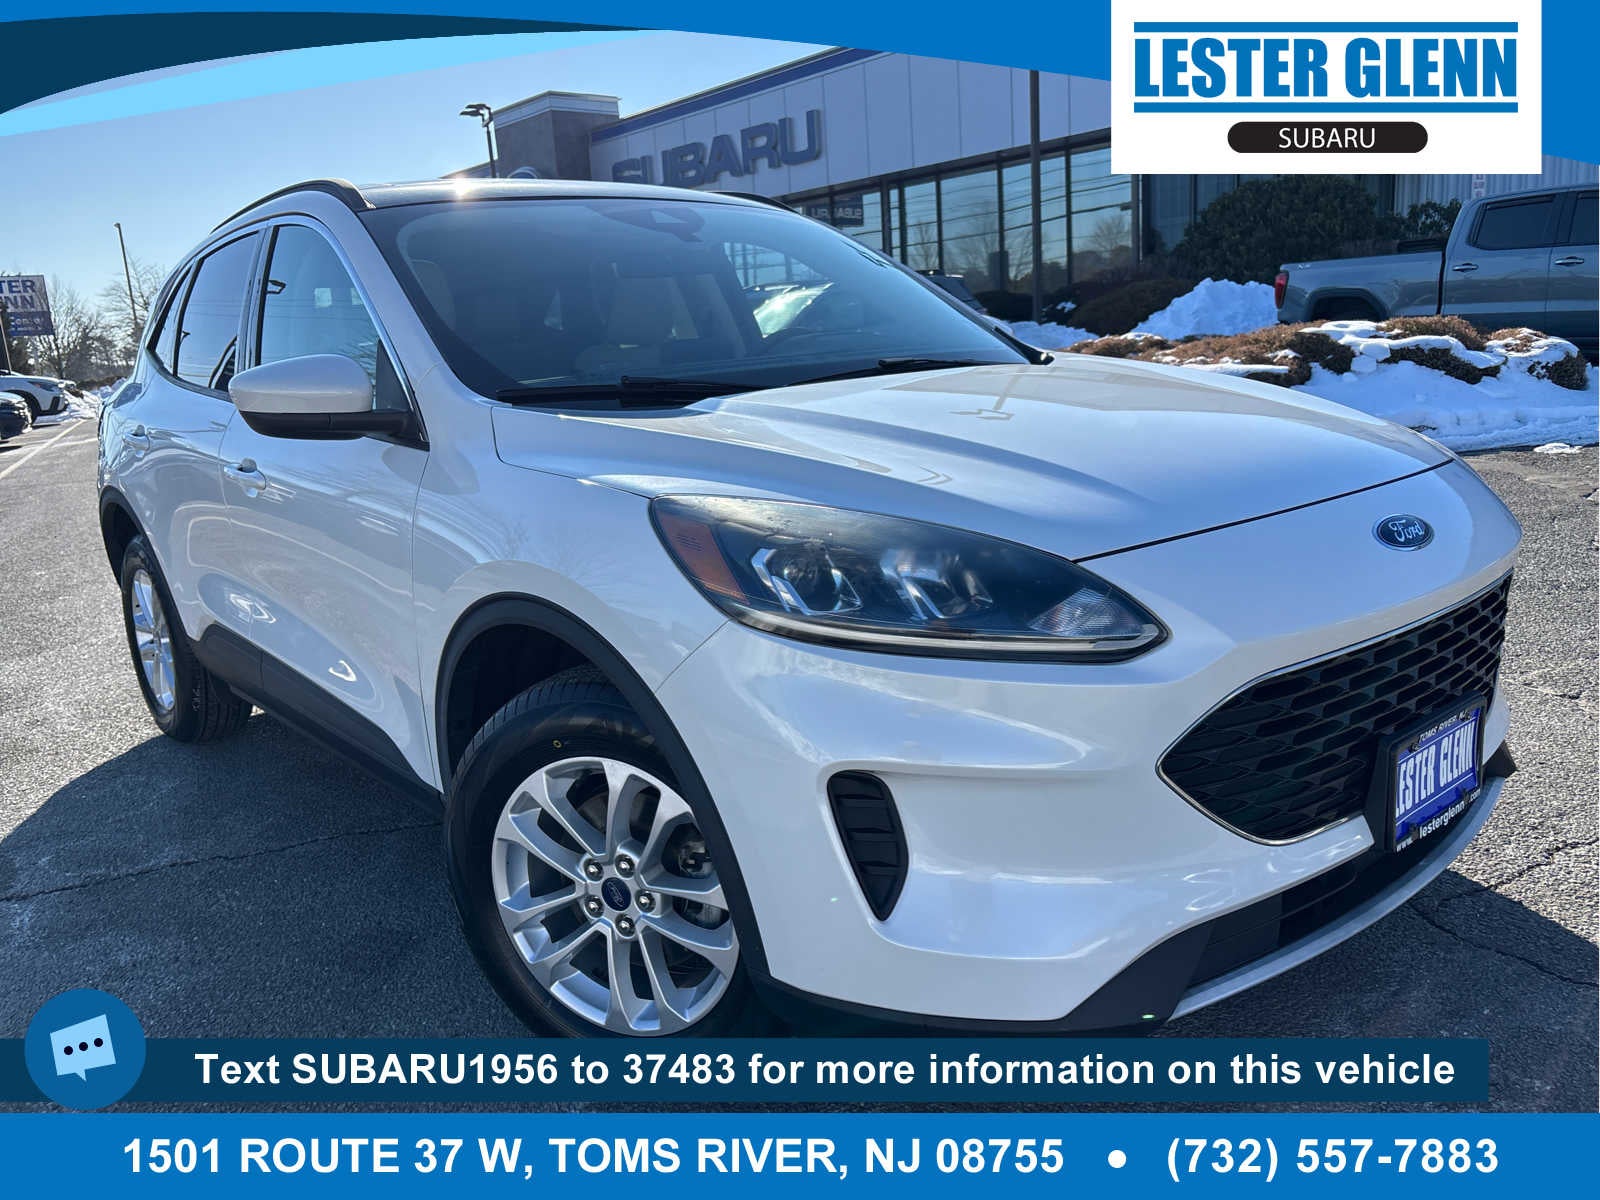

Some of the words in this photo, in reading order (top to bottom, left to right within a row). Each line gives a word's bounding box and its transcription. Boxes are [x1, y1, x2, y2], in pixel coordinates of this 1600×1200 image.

[612, 110, 821, 188] SUBARU
[1388, 519, 1425, 542] Ford
[1396, 744, 1436, 818] LESTER
[1440, 720, 1475, 788] GLENN
